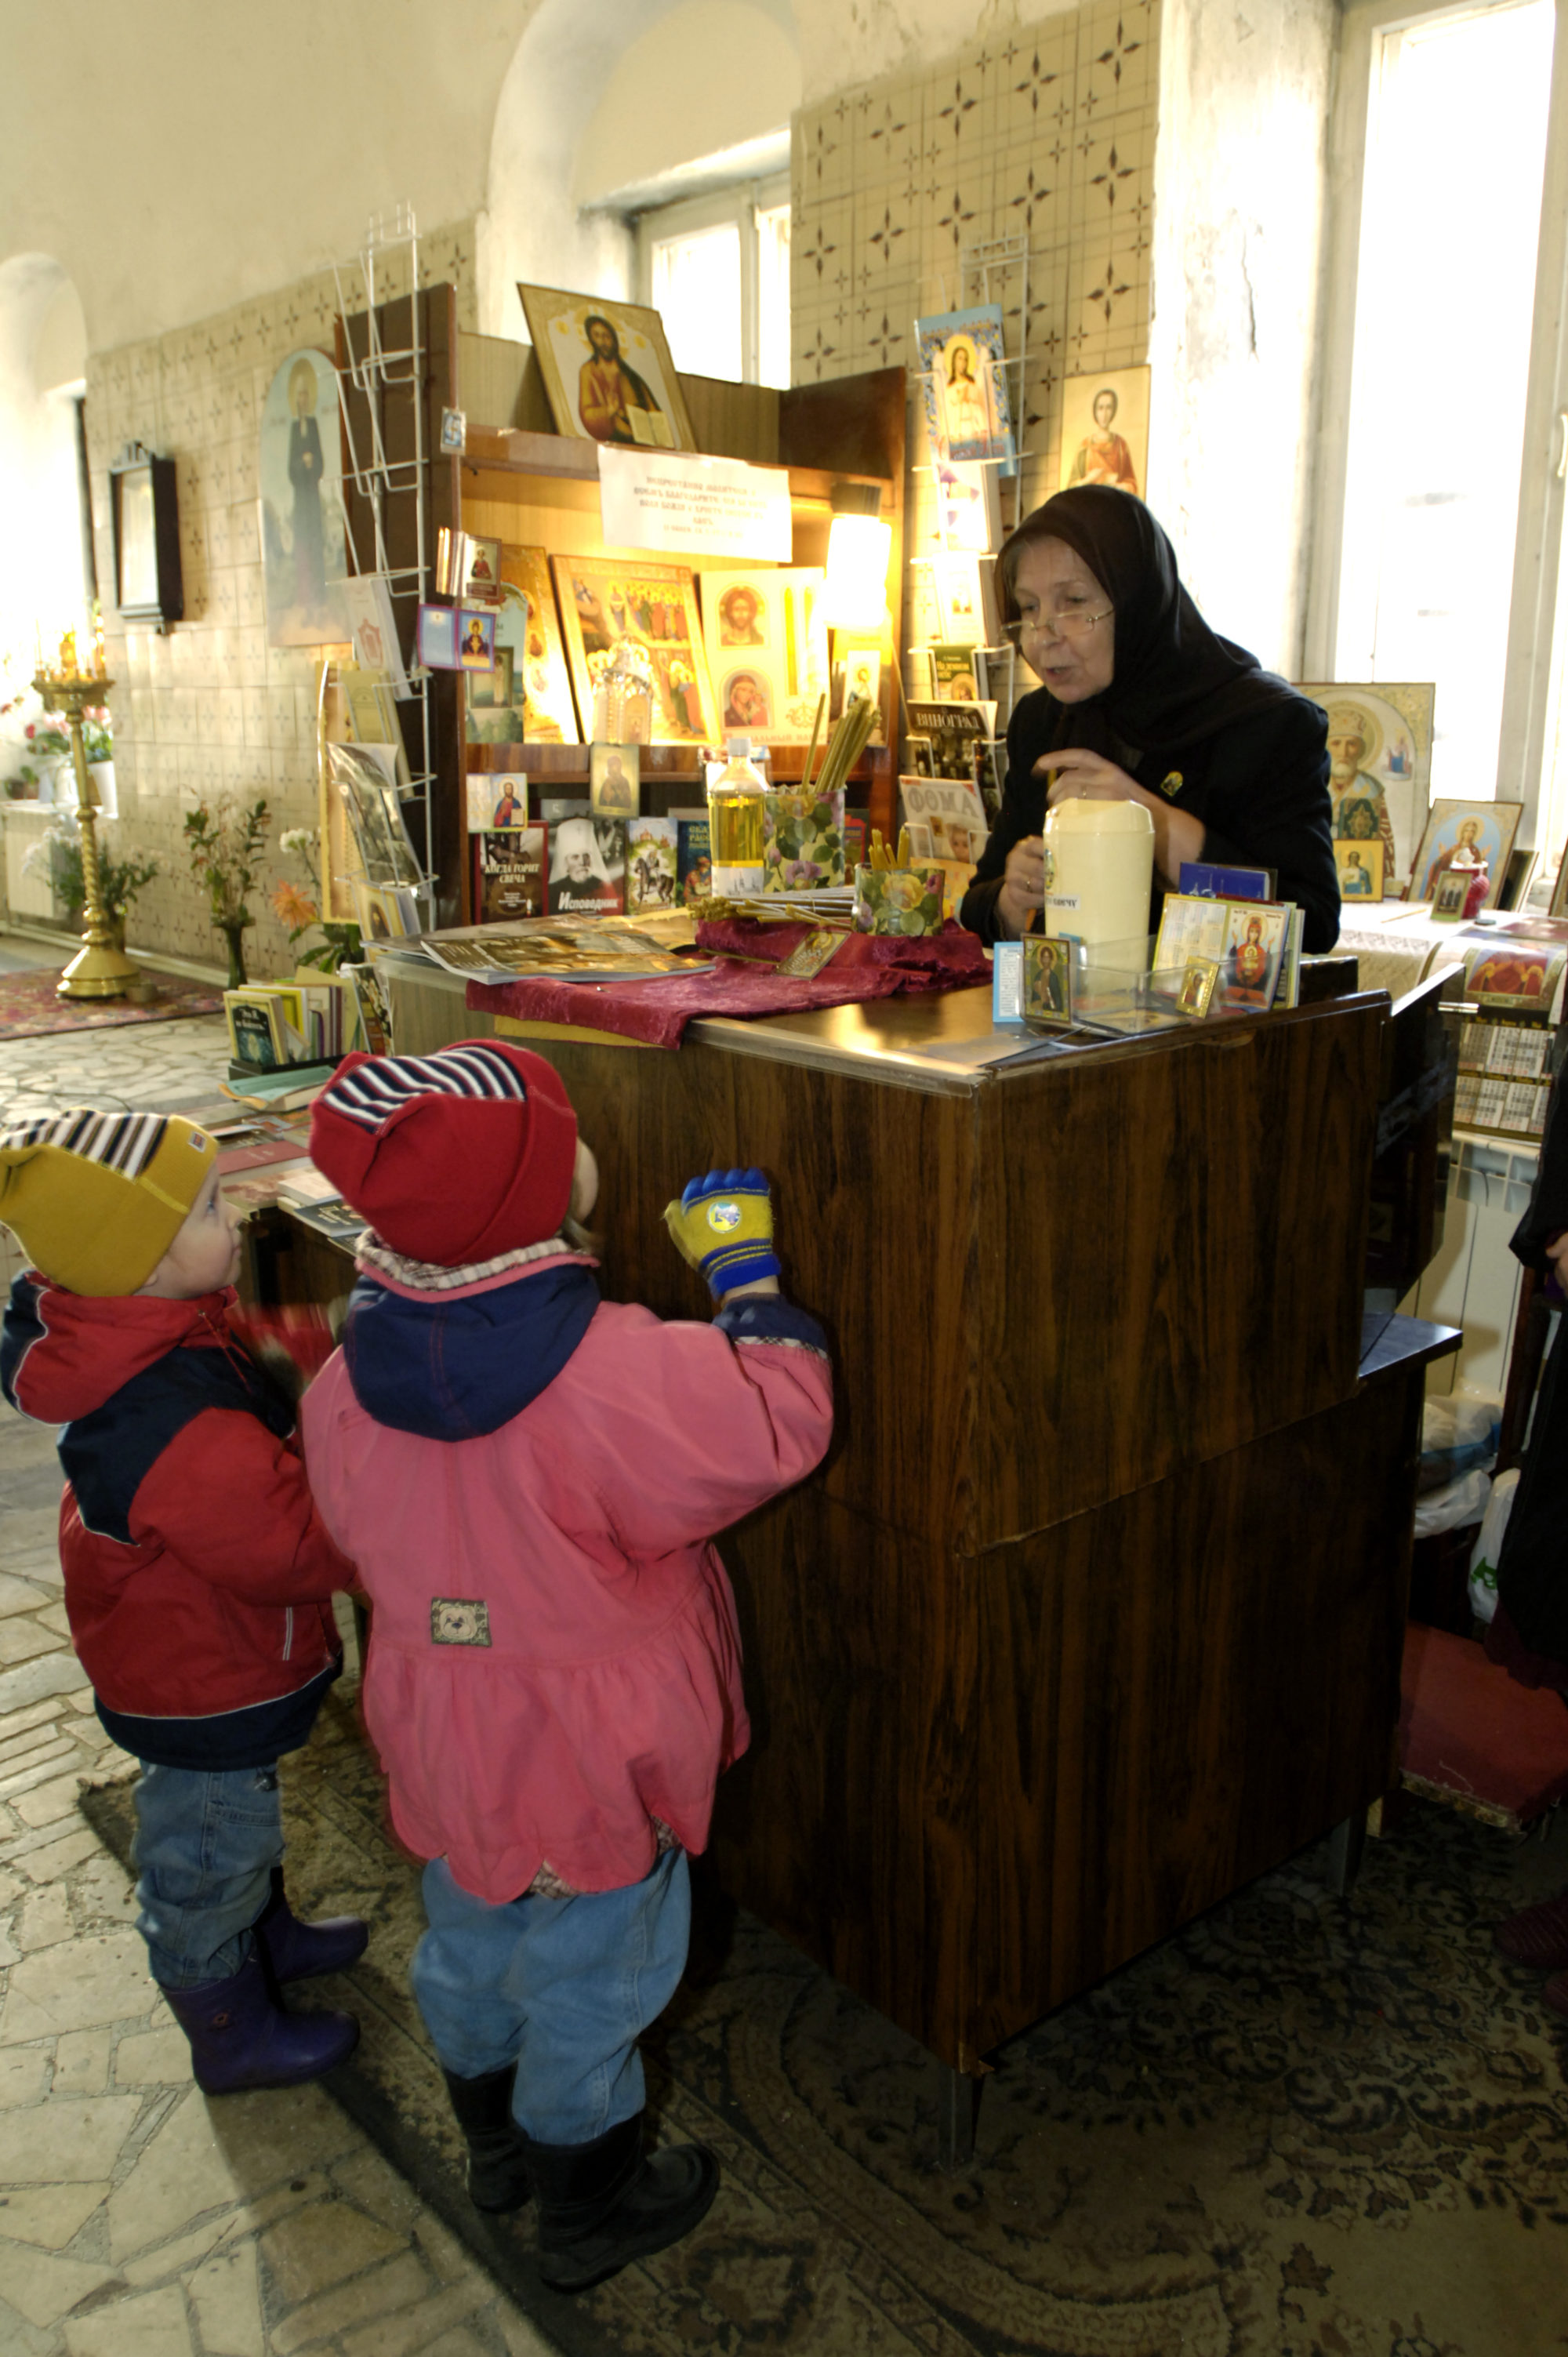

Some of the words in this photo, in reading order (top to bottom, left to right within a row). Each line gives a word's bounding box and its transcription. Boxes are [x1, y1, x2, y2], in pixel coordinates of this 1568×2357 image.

[916, 713, 981, 728] ВИНОГРАД
[908, 787, 979, 819] ФОМА
[485, 863, 512, 873] КОГДА
[514, 863, 540, 873] ГОРИТ
[499, 874, 525, 884] СВЕЧА
[558, 892, 619, 911] Исповедник
